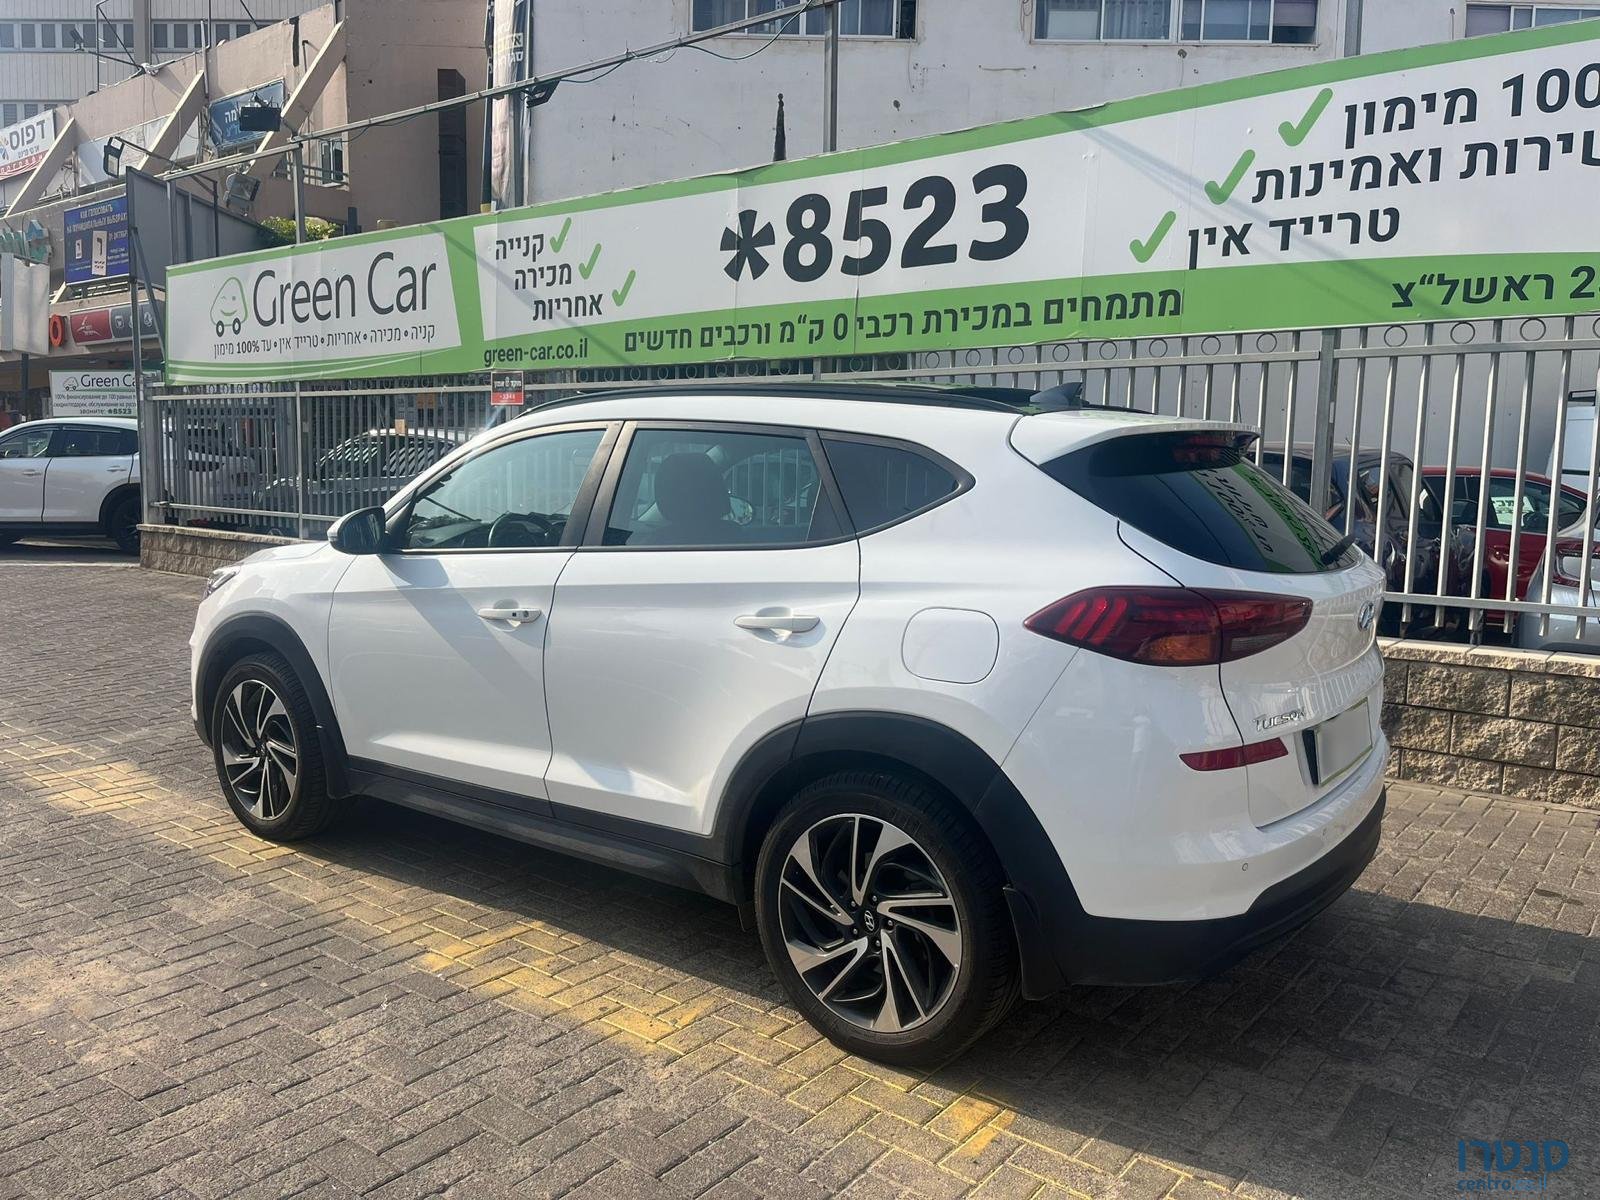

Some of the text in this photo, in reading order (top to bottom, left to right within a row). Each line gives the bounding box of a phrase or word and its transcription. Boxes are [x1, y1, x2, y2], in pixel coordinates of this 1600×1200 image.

[1344, 87, 1477, 149] מימון
[9, 120, 46, 151] דפוס
[1251, 146, 1441, 203] ואמינות
[495, 233, 544, 262] קנייה
[1188, 206, 1400, 269] טרייד אין
[253, 251, 436, 327] Green Car
[514, 263, 572, 290] מכירה
[1569, 265, 1600, 300] 2
[533, 294, 603, 321] אחריות
[921, 302, 1032, 335] במכירת
[1043, 289, 1182, 325] מתמחים
[624, 328, 692, 352] חדשים
[700, 322, 771, 348] ורכבים
[833, 313, 848, 341] 0
[856, 312, 913, 339] רכבי
[213, 325, 436, 359] קניה מכירה אחריות טרייד אין עד 100% מימון
[484, 338, 588, 367] green-car.co.il
[80, 374, 136, 387] Green Ca
[1252, 706, 1306, 732] TUCSON
